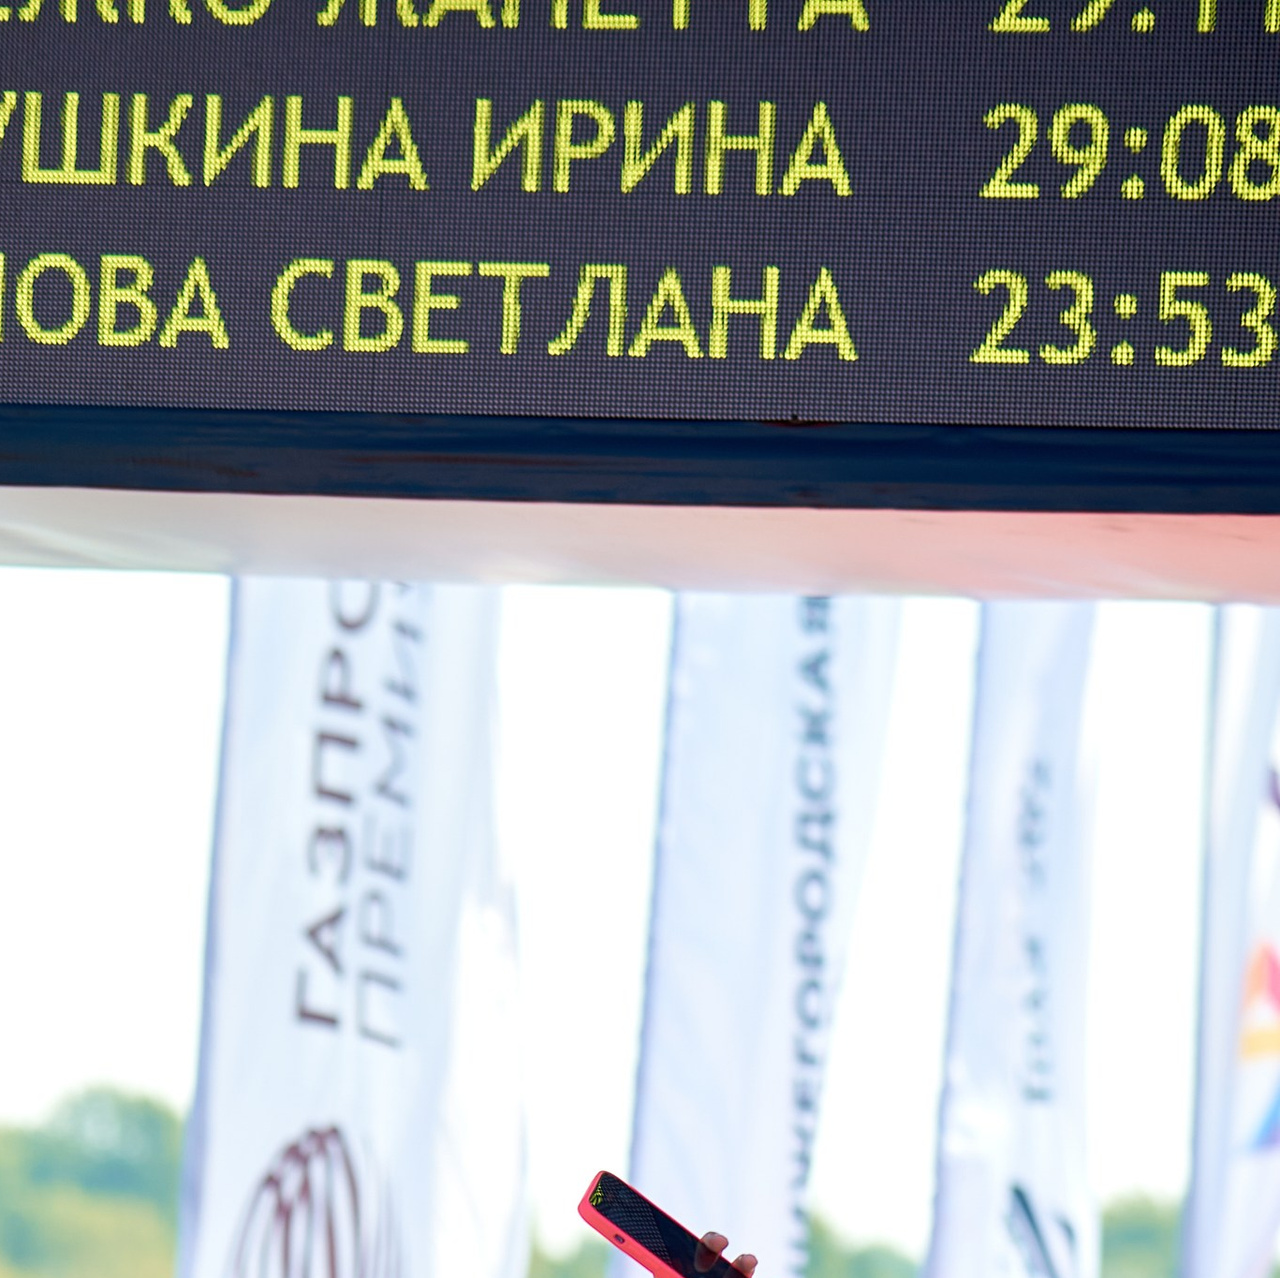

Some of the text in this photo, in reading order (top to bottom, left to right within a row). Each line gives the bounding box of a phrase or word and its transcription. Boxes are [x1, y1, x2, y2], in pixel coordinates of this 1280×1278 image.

[471, 99, 853, 196] ИРИНА
[979, 104, 1280, 201] 29:08
[271, 259, 858, 361] СВЕТЛАНА
[969, 270, 1278, 367] 23:53
[357, 582, 428, 1049] ПРЕМИ
